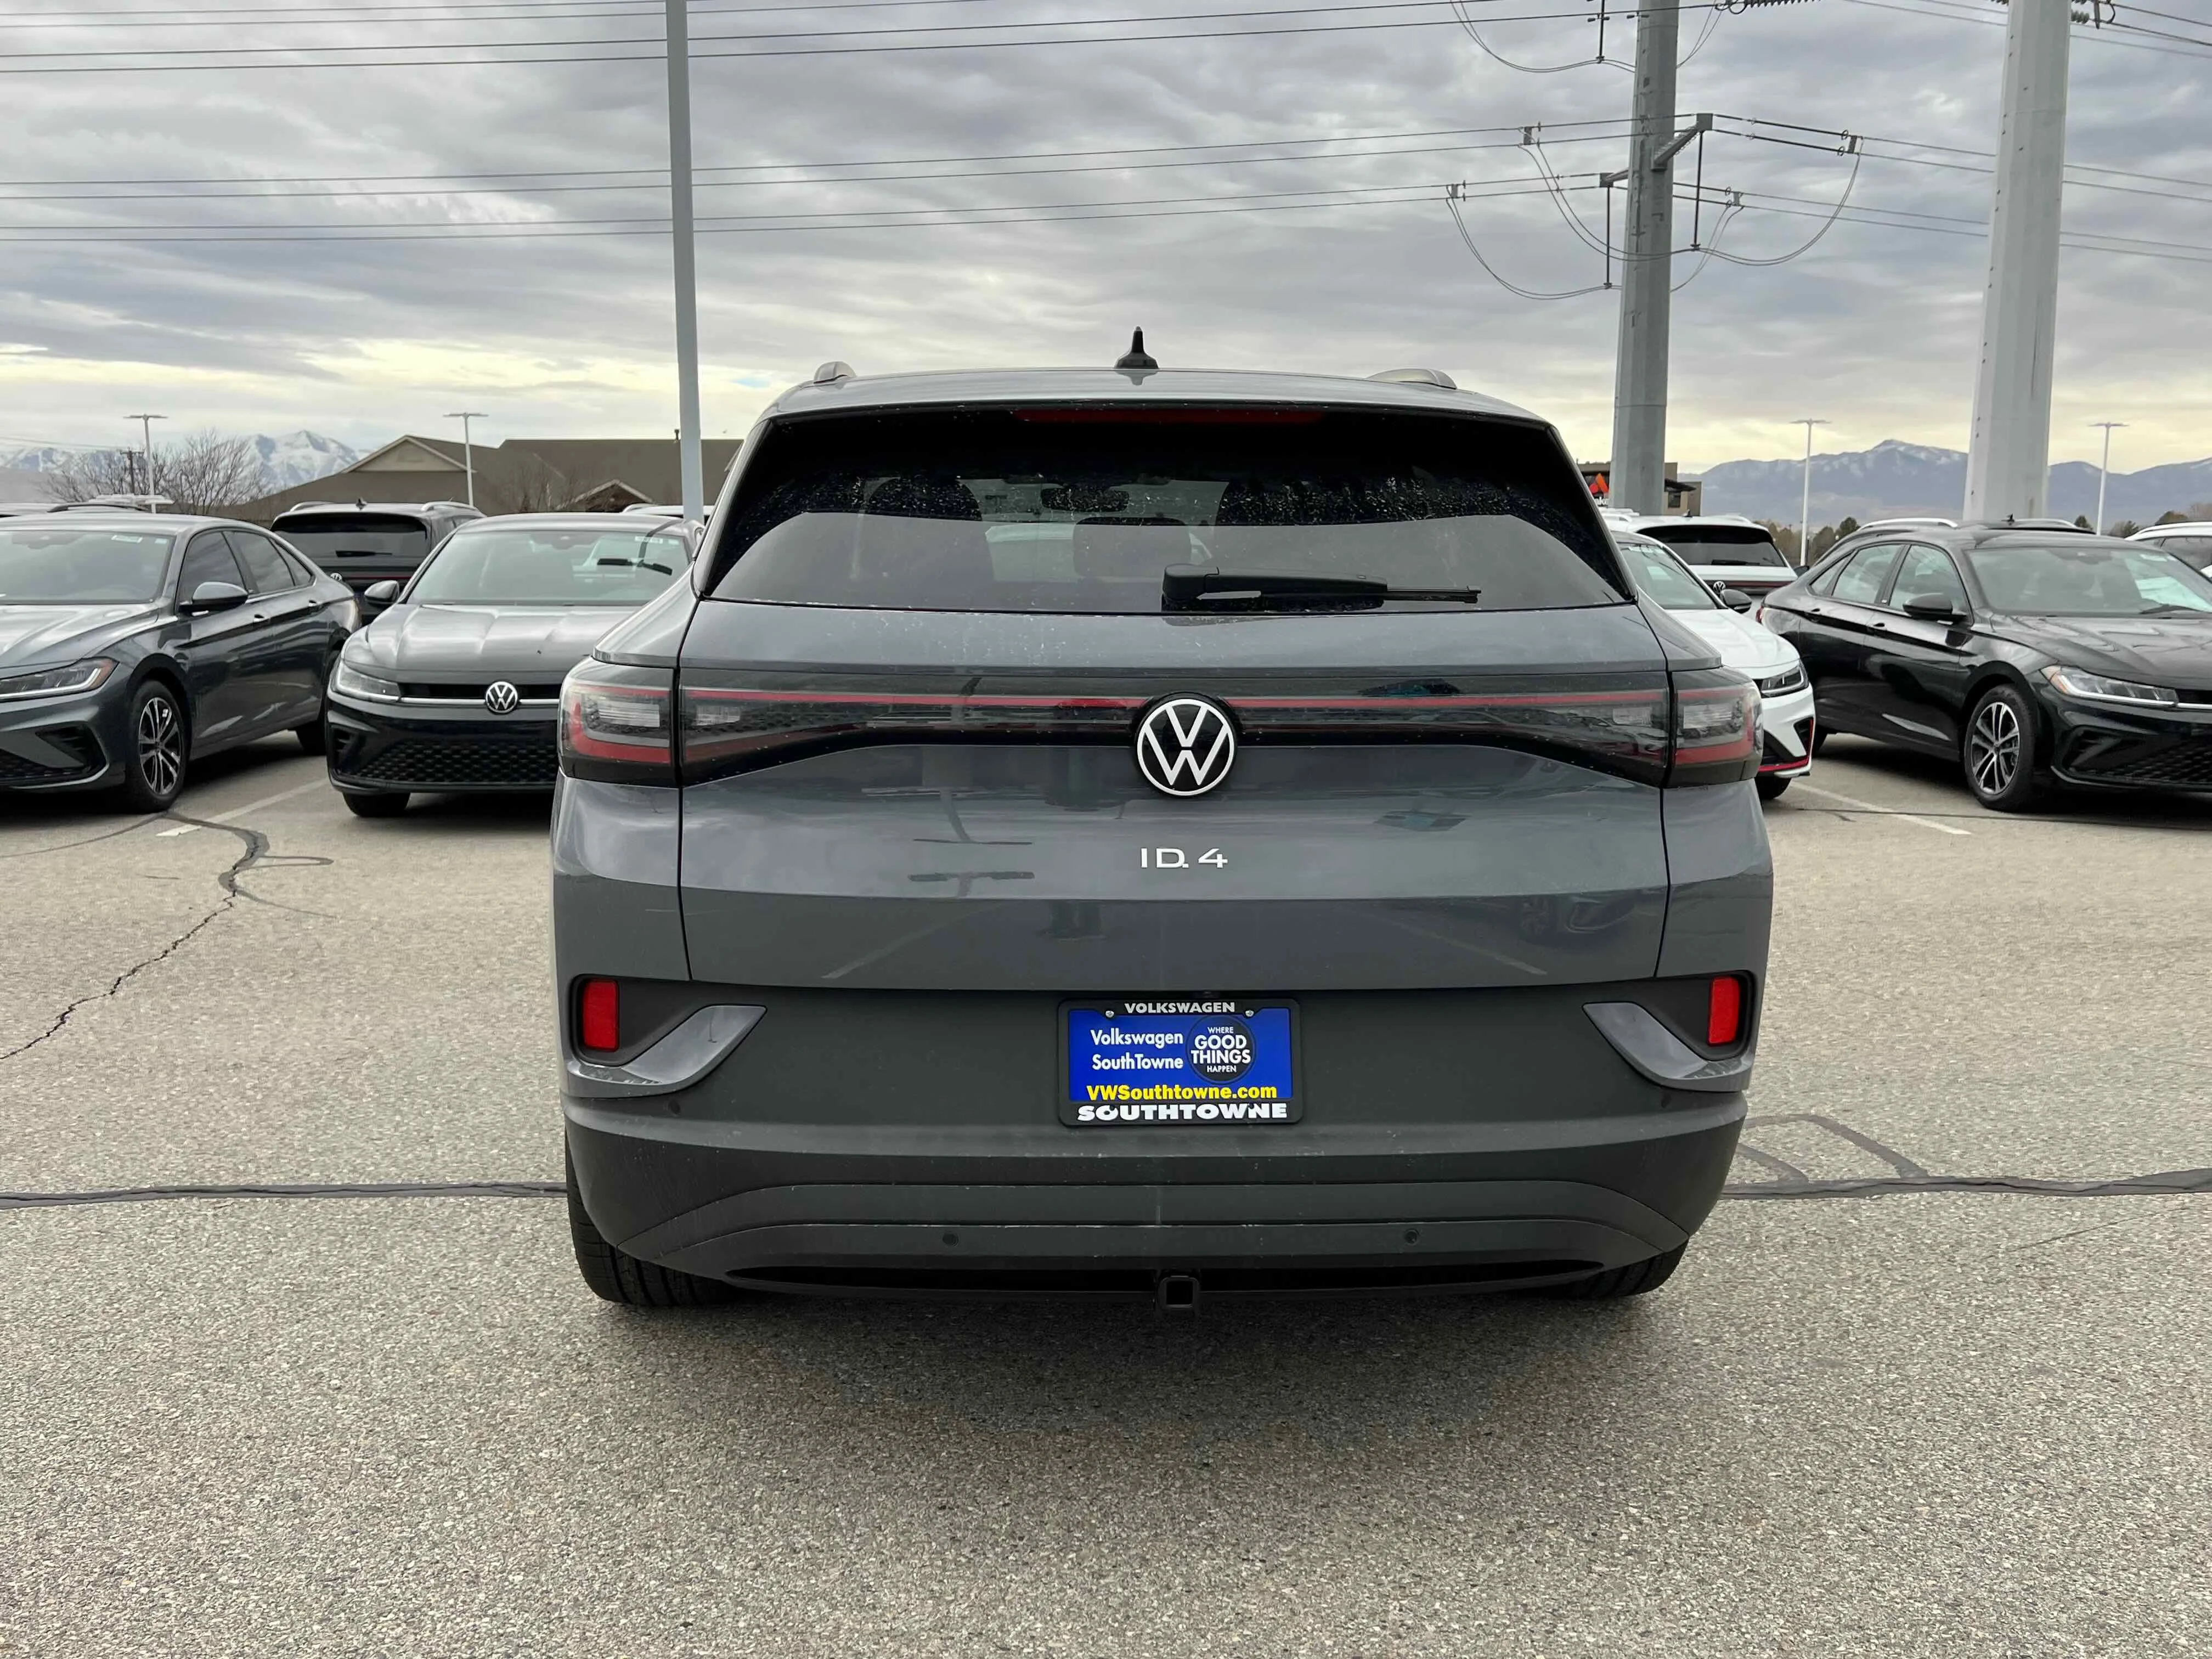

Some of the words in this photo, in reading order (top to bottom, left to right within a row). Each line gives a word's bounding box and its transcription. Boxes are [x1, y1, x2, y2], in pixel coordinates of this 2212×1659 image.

[486, 681, 518, 713] VW
[1138, 699, 1234, 795] VW
[1124, 1002, 1235, 1014] VOLKSWAGEN
[1090, 1028, 1183, 1049] Volkswagen
[1194, 1035, 1247, 1049] GOOD
[1092, 1052, 1183, 1070] SouthTowne
[1190, 1049, 1251, 1064] THINGS
[1206, 1065, 1237, 1073] HAPPEN
[1086, 1084, 1277, 1101] VWSouthtowne.com
[1077, 1103, 1288, 1121] SOUTHTOWNE
